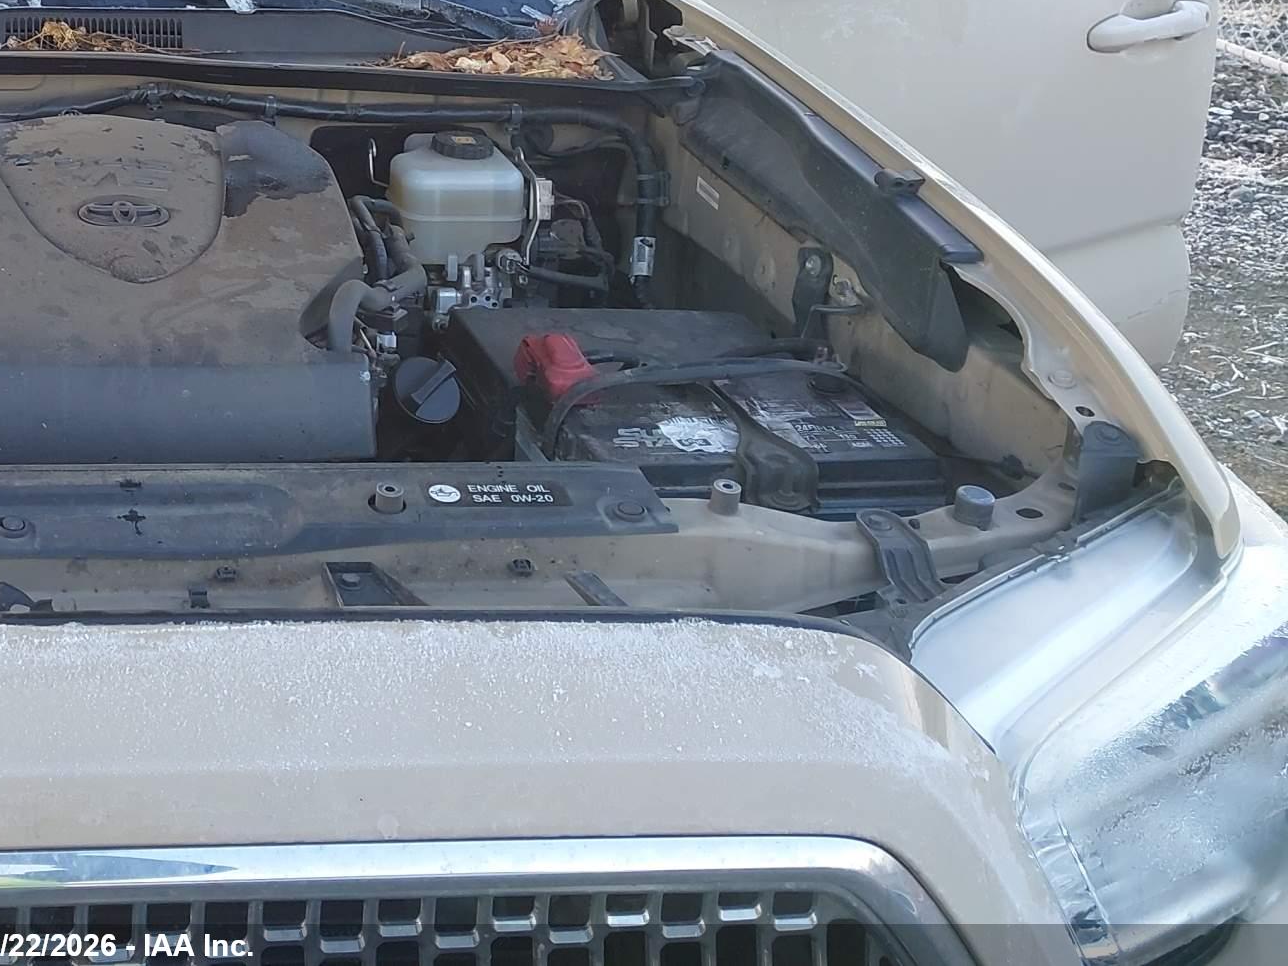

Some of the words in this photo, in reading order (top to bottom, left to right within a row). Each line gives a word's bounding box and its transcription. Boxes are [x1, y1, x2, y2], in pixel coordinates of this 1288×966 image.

[467, 484, 519, 494] ENGINE
[526, 484, 551, 494] OIL
[472, 494, 502, 503] SAE
[511, 494, 554, 503] 0W-20
